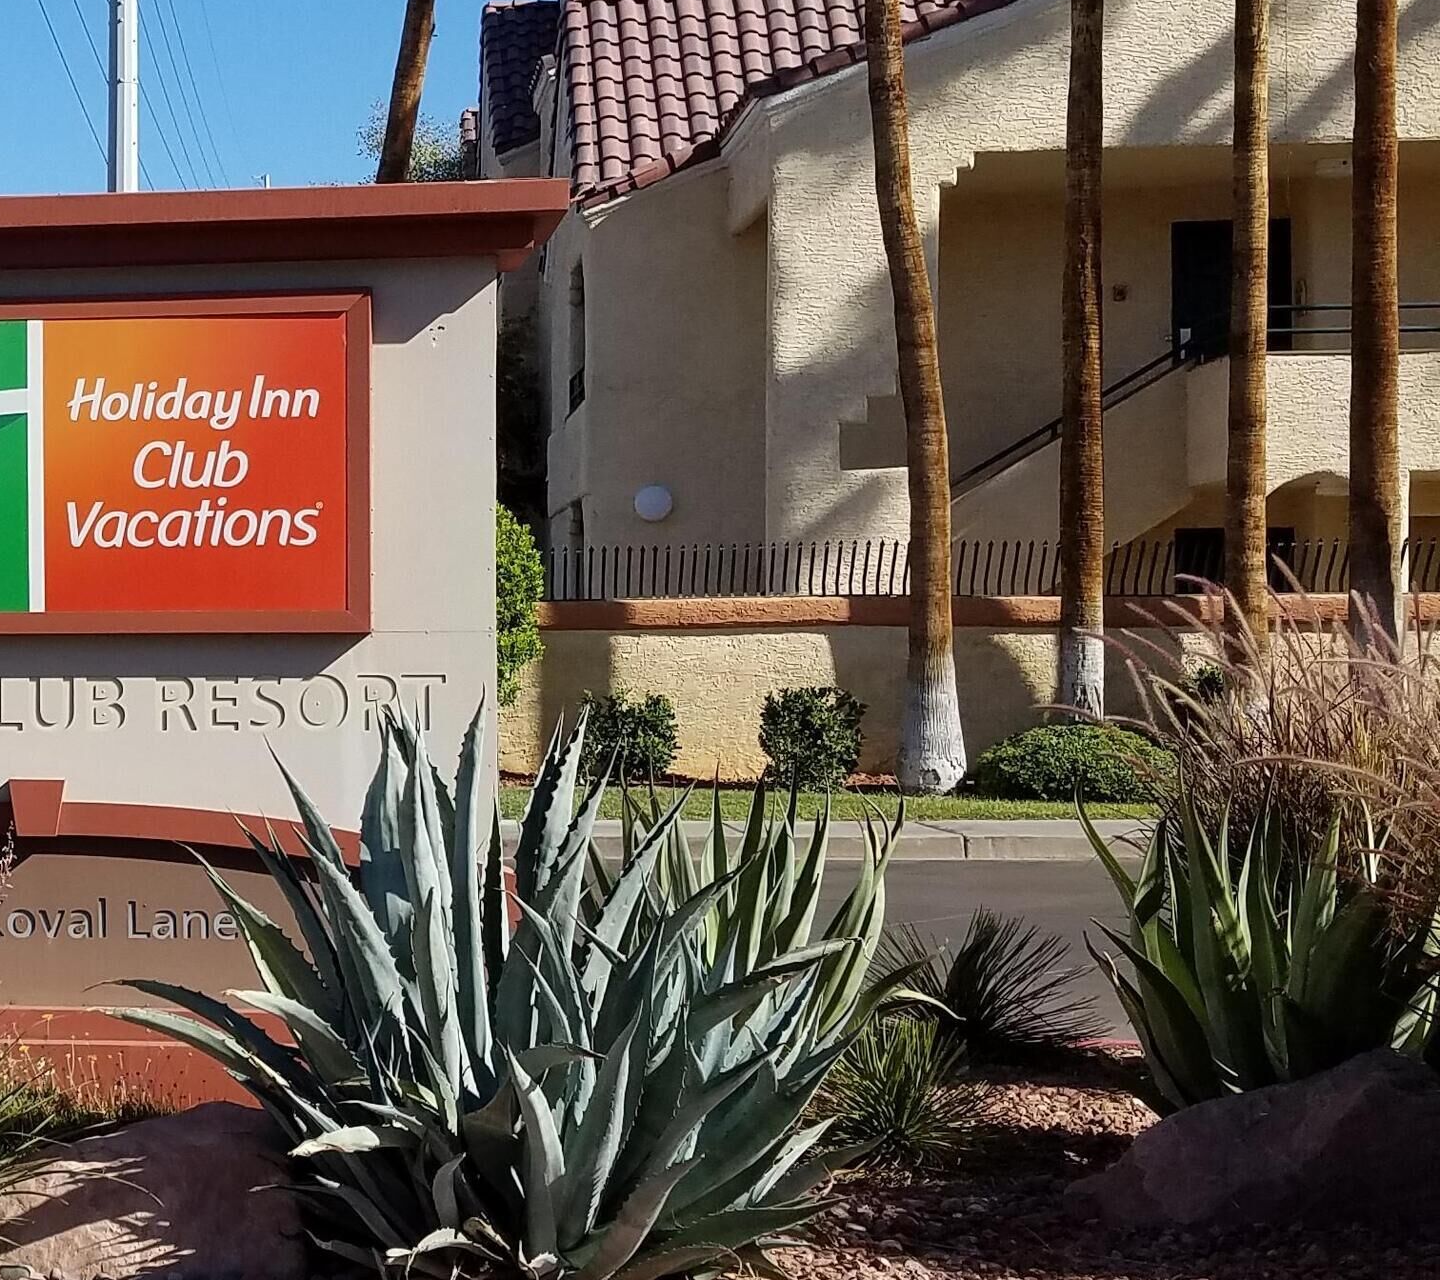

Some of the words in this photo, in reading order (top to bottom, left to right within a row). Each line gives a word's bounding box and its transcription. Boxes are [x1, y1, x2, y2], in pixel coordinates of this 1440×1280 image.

[66, 376, 244, 431] Holiday
[247, 373, 322, 421] Inn
[132, 439, 249, 490] Club
[66, 497, 323, 549] Vacations
[156, 673, 447, 732] RESORT
[126, 899, 241, 940] Lane
